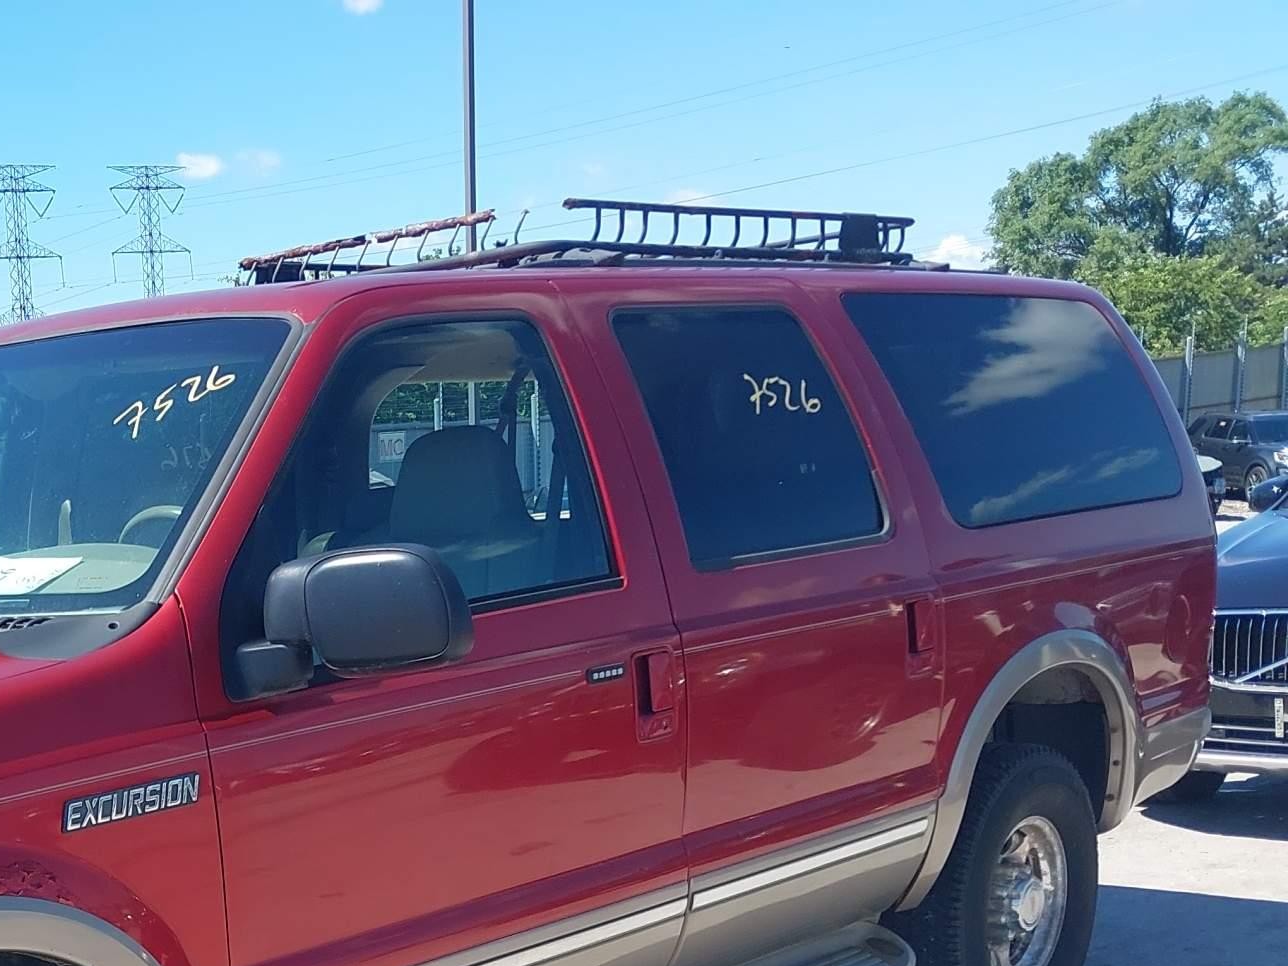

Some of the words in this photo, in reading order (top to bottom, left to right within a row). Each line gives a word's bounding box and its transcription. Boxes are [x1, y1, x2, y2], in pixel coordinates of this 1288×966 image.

[112, 364, 237, 440] 7526
[743, 373, 822, 416] 7526
[65, 774, 201, 832] EXCURSION
